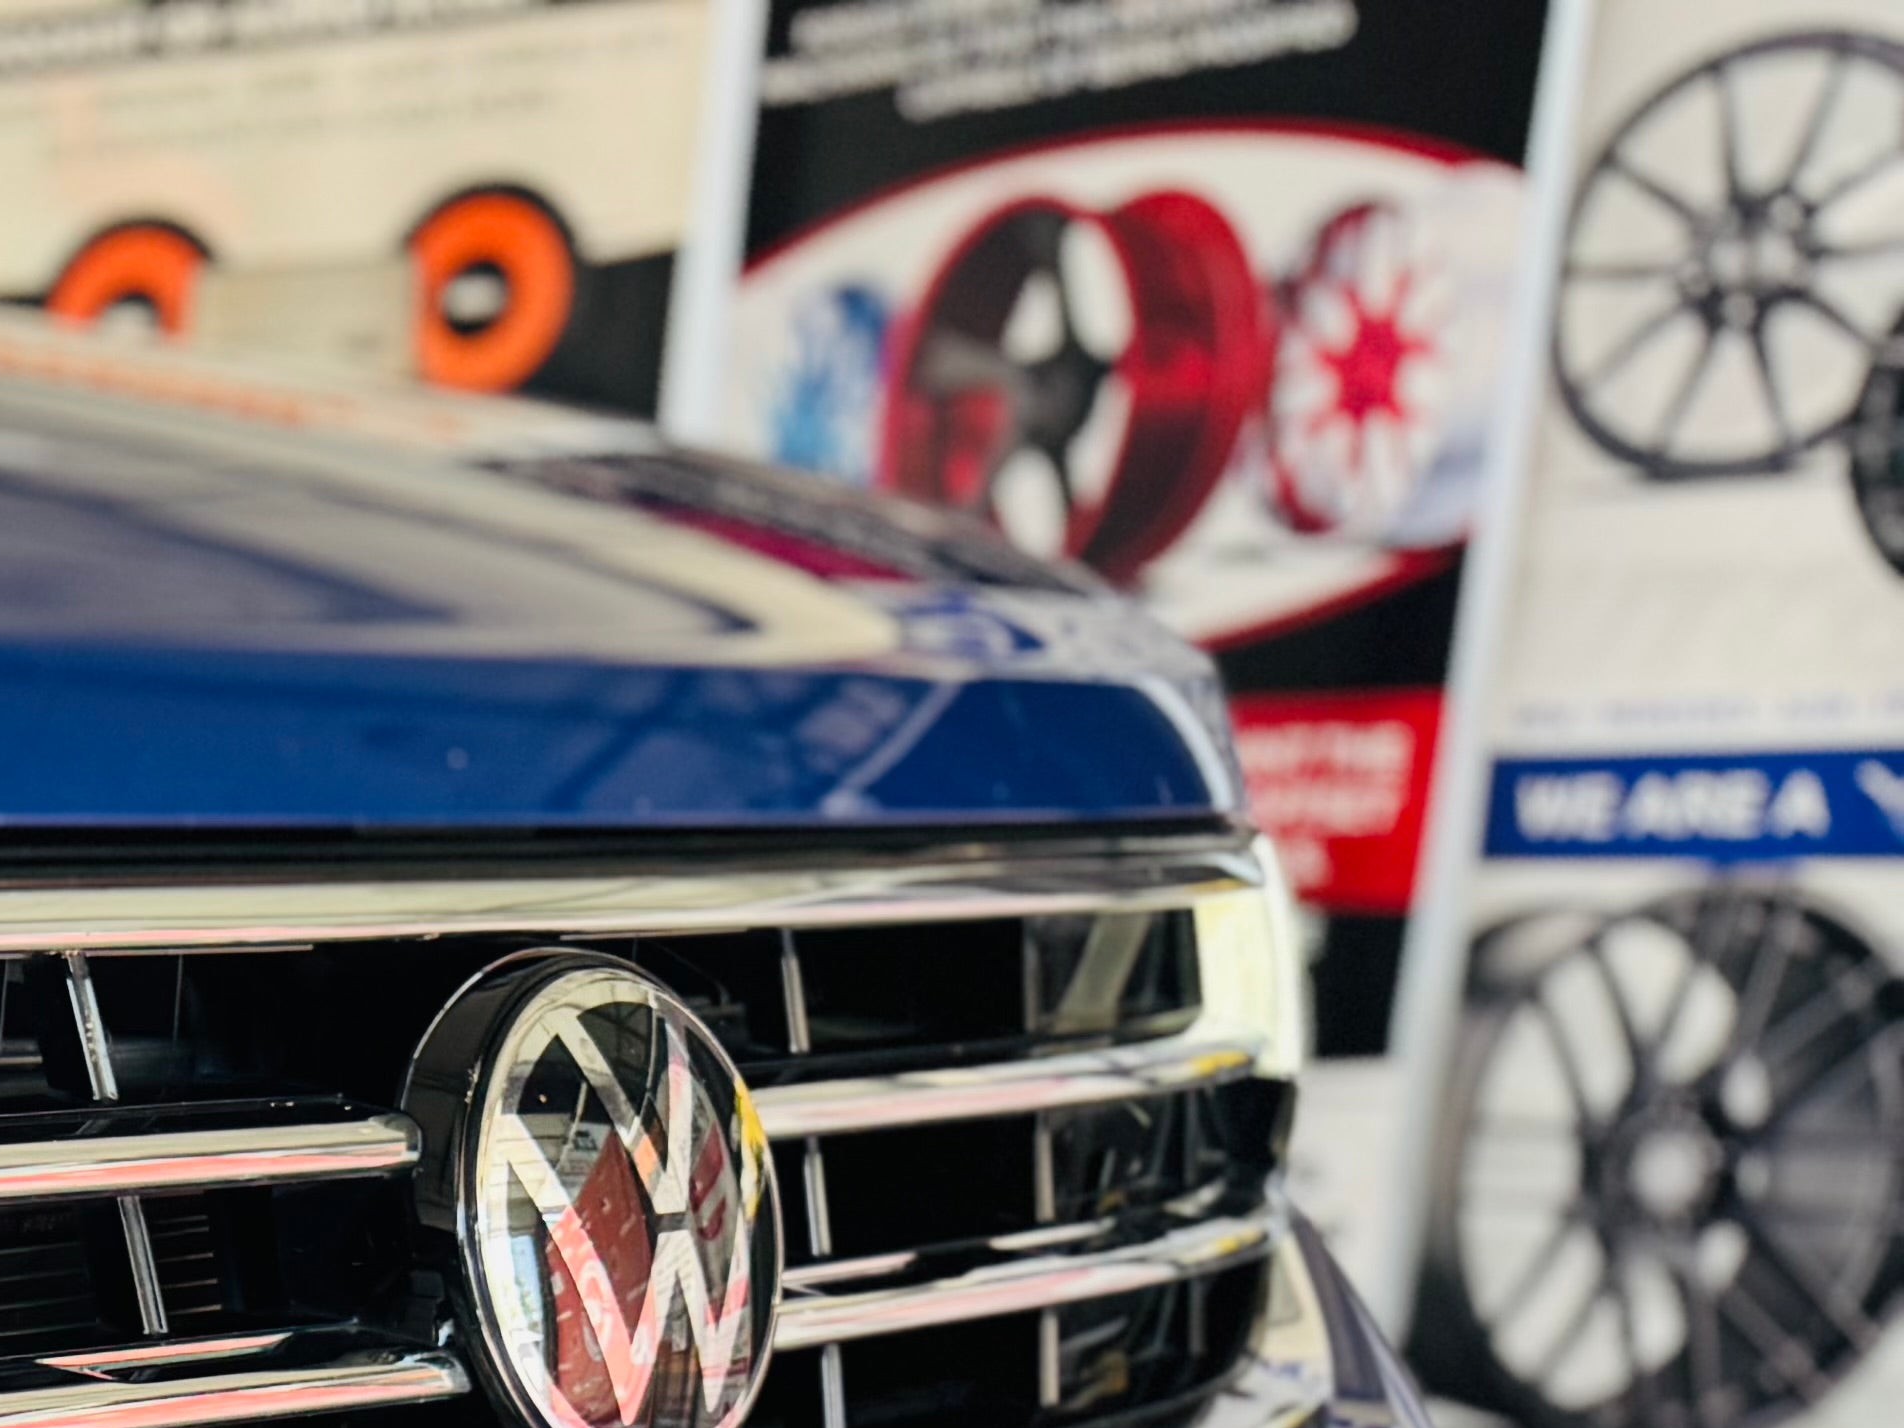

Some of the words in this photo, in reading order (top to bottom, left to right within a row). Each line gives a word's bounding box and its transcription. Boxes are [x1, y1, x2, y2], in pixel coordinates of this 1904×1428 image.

[1514, 768, 1624, 843] WE
[1624, 766, 1772, 841] ARE
[1768, 766, 1833, 839] A
